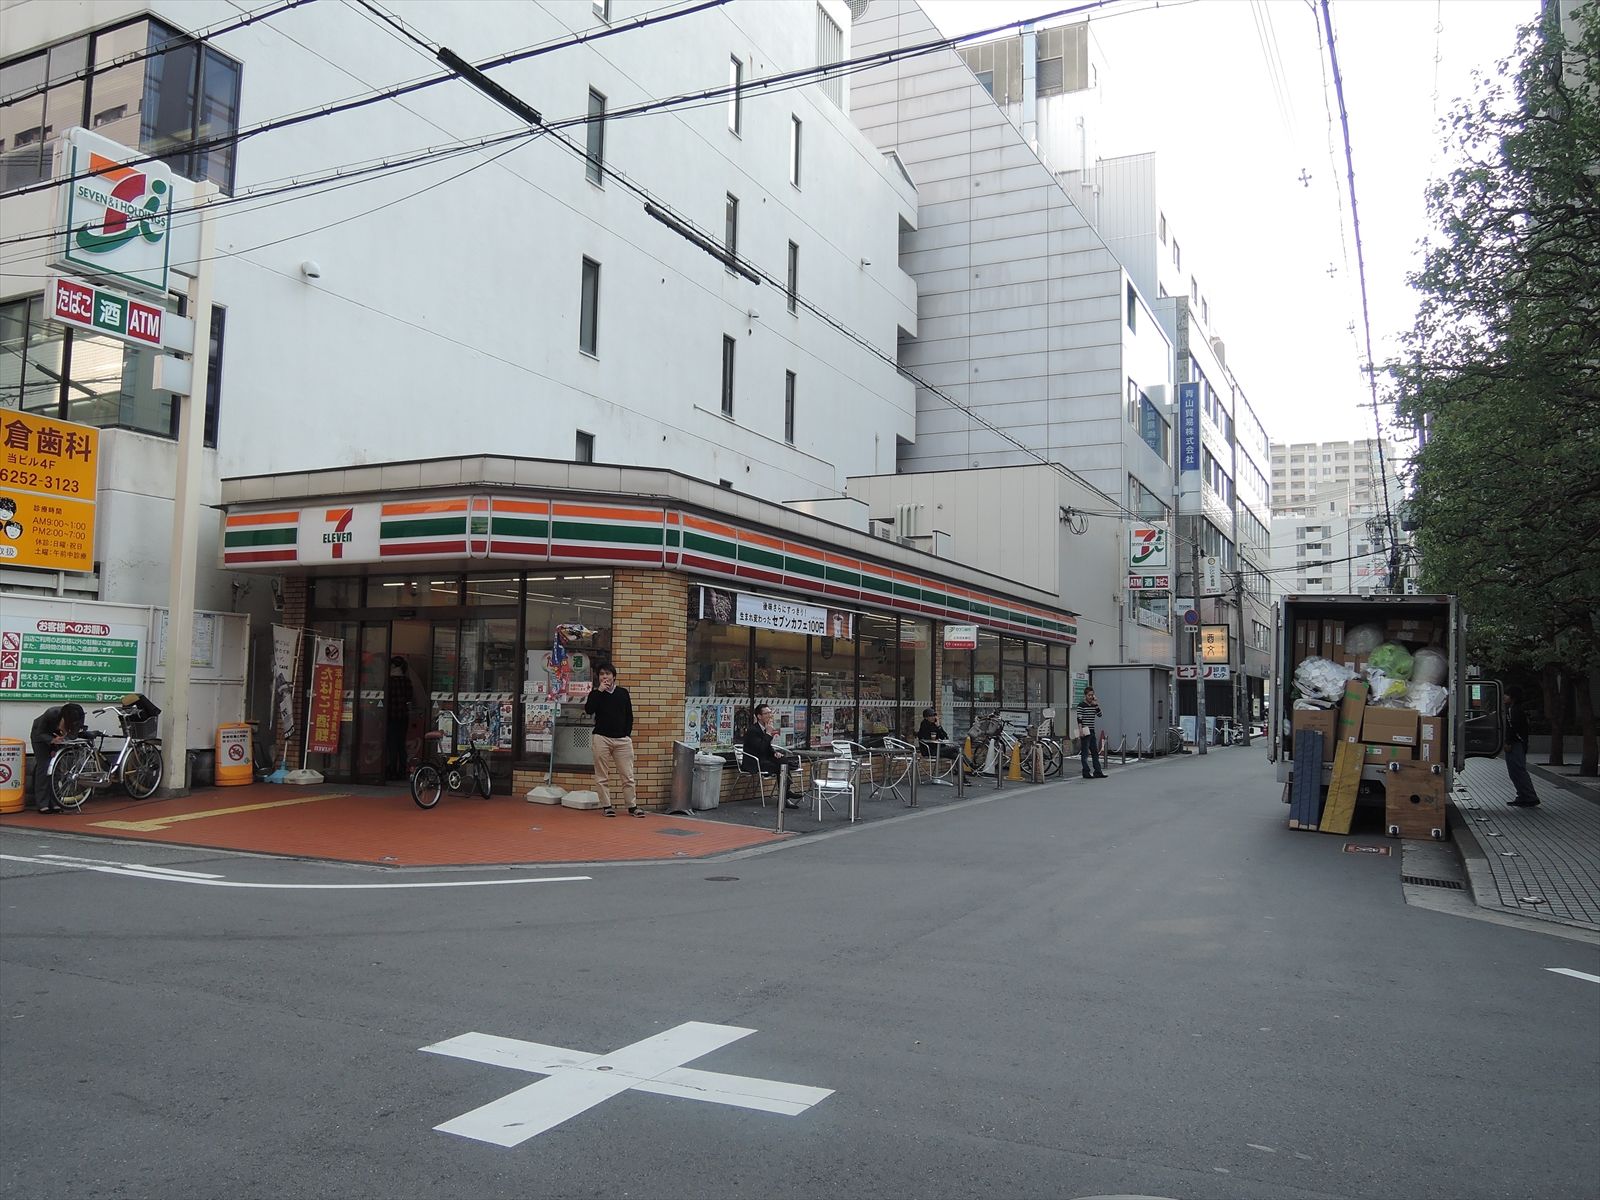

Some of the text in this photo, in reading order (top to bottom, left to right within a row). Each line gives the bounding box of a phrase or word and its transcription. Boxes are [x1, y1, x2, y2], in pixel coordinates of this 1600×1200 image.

[57, 287, 92, 318] たばこ
[100, 299, 121, 327] 酒
[129, 309, 160, 338] ATM
[0, 417, 91, 462] 倉歯科
[1185, 389, 1194, 464] 青山貿易株式会社
[7, 453, 56, 469] 当ビル4F
[0, 468, 79, 493] 6252-3123
[33, 504, 62, 515] 診療時間
[38, 621, 109, 635] お客様へのお願い
